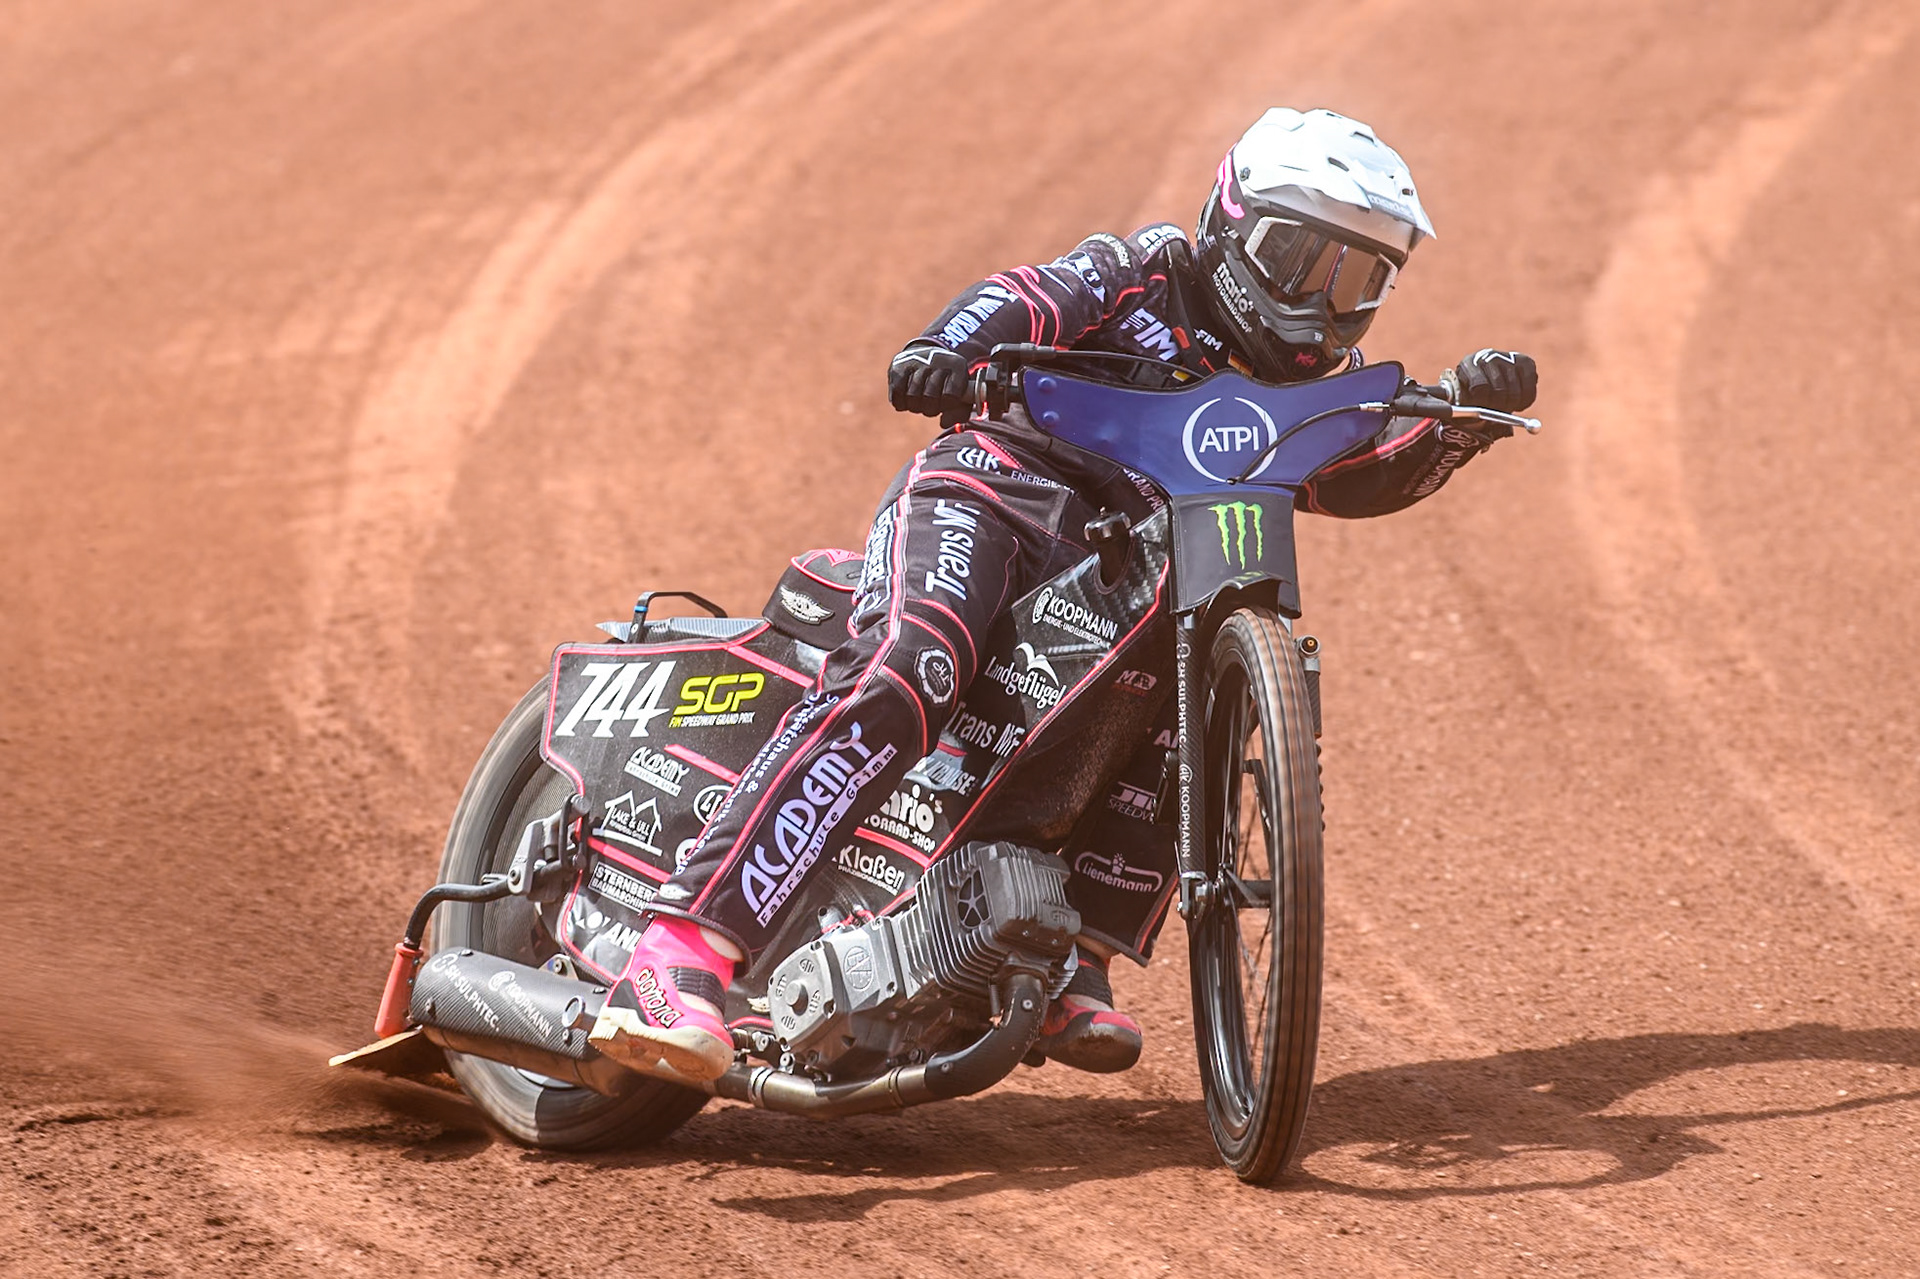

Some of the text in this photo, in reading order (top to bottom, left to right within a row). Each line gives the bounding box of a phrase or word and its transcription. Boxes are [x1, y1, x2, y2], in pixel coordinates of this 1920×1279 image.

[1216, 262, 1254, 313] mario's
[1119, 308, 1179, 362] FIM
[1193, 328, 1224, 352] FIM
[1198, 426, 1260, 454] ATPI
[925, 527, 975, 601] Trans
[1046, 595, 1118, 641] KOOPMANN
[555, 660, 677, 738] 744
[673, 672, 765, 716] SGP
[681, 713, 716, 728] SPEEDWAY
[945, 701, 998, 749] Trans
[630, 746, 690, 785] ACADEMY
[741, 721, 872, 914] ACADEMY
[879, 784, 943, 834] ario's
[1180, 786, 1191, 858] KOOPMANN
[760, 811, 840, 925] Fahrschule
[845, 747, 895, 800] Grimm
[838, 844, 906, 891] Klaßen
[1082, 861, 1153, 893] Lienemann
[504, 981, 553, 1038] KOOPMANN
[634, 968, 686, 1029] daytona
